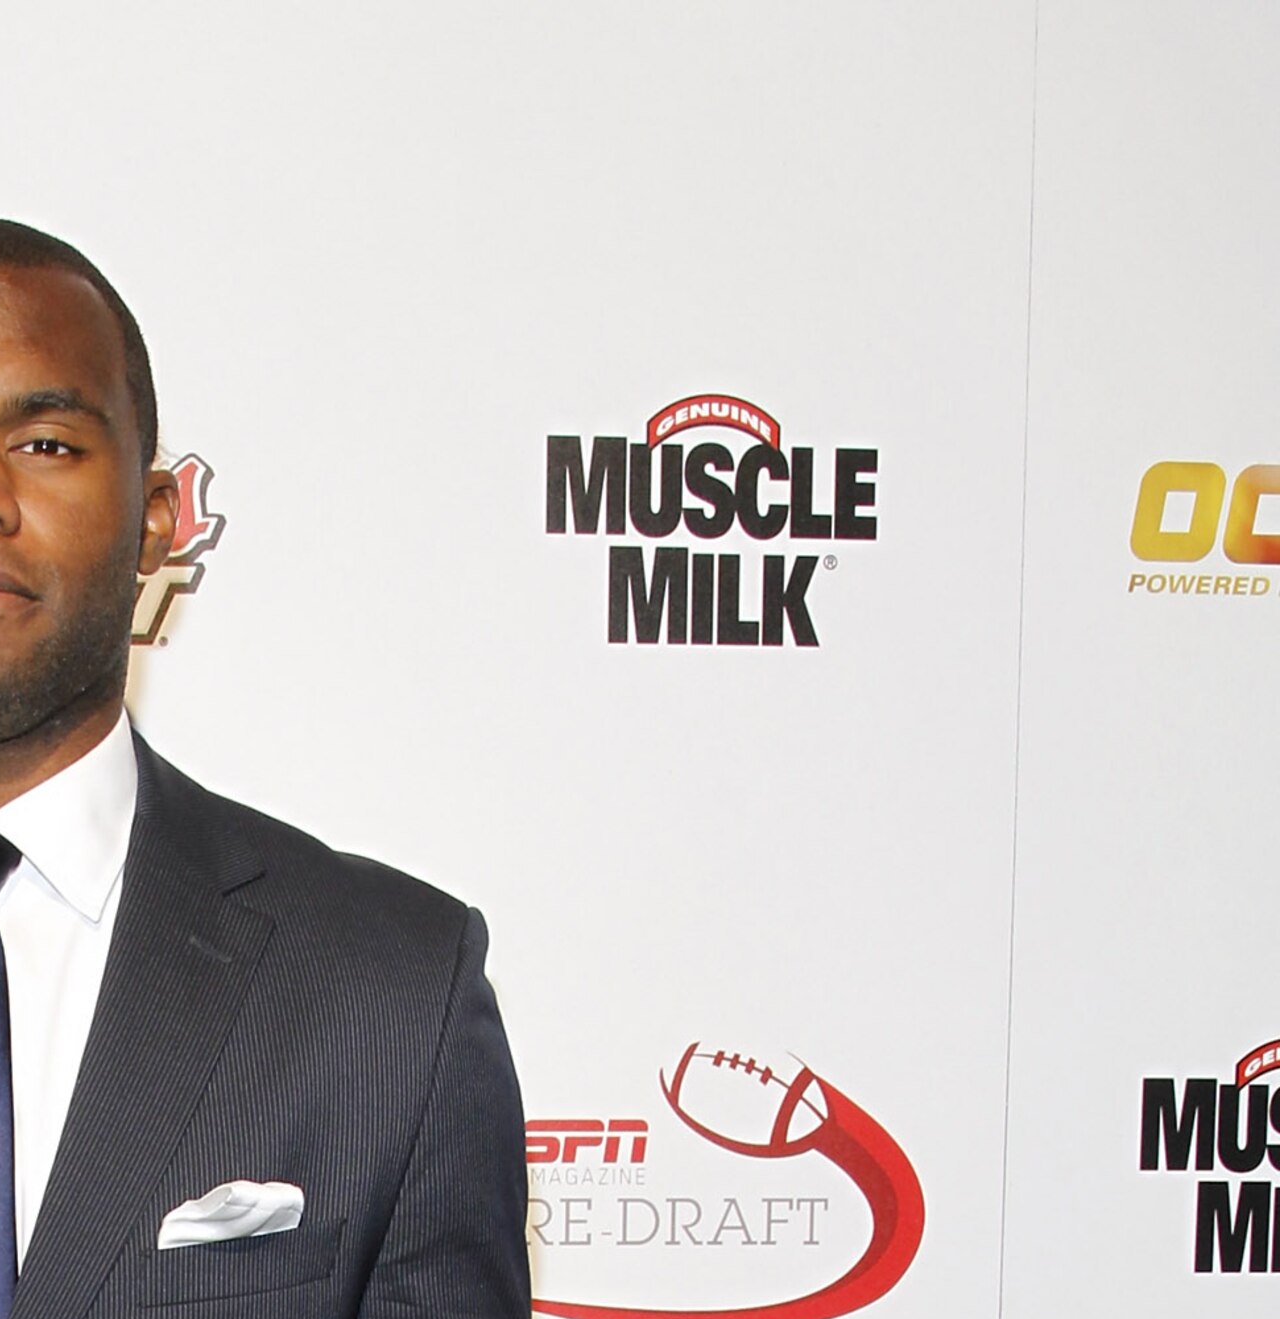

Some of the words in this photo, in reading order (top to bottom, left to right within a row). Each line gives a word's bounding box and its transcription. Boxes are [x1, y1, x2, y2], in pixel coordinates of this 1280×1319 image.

[656, 403, 772, 443] GENUINE
[546, 435, 878, 541] MUSCLE
[608, 546, 820, 647] MILK
[1128, 574, 1271, 596] POWERED
